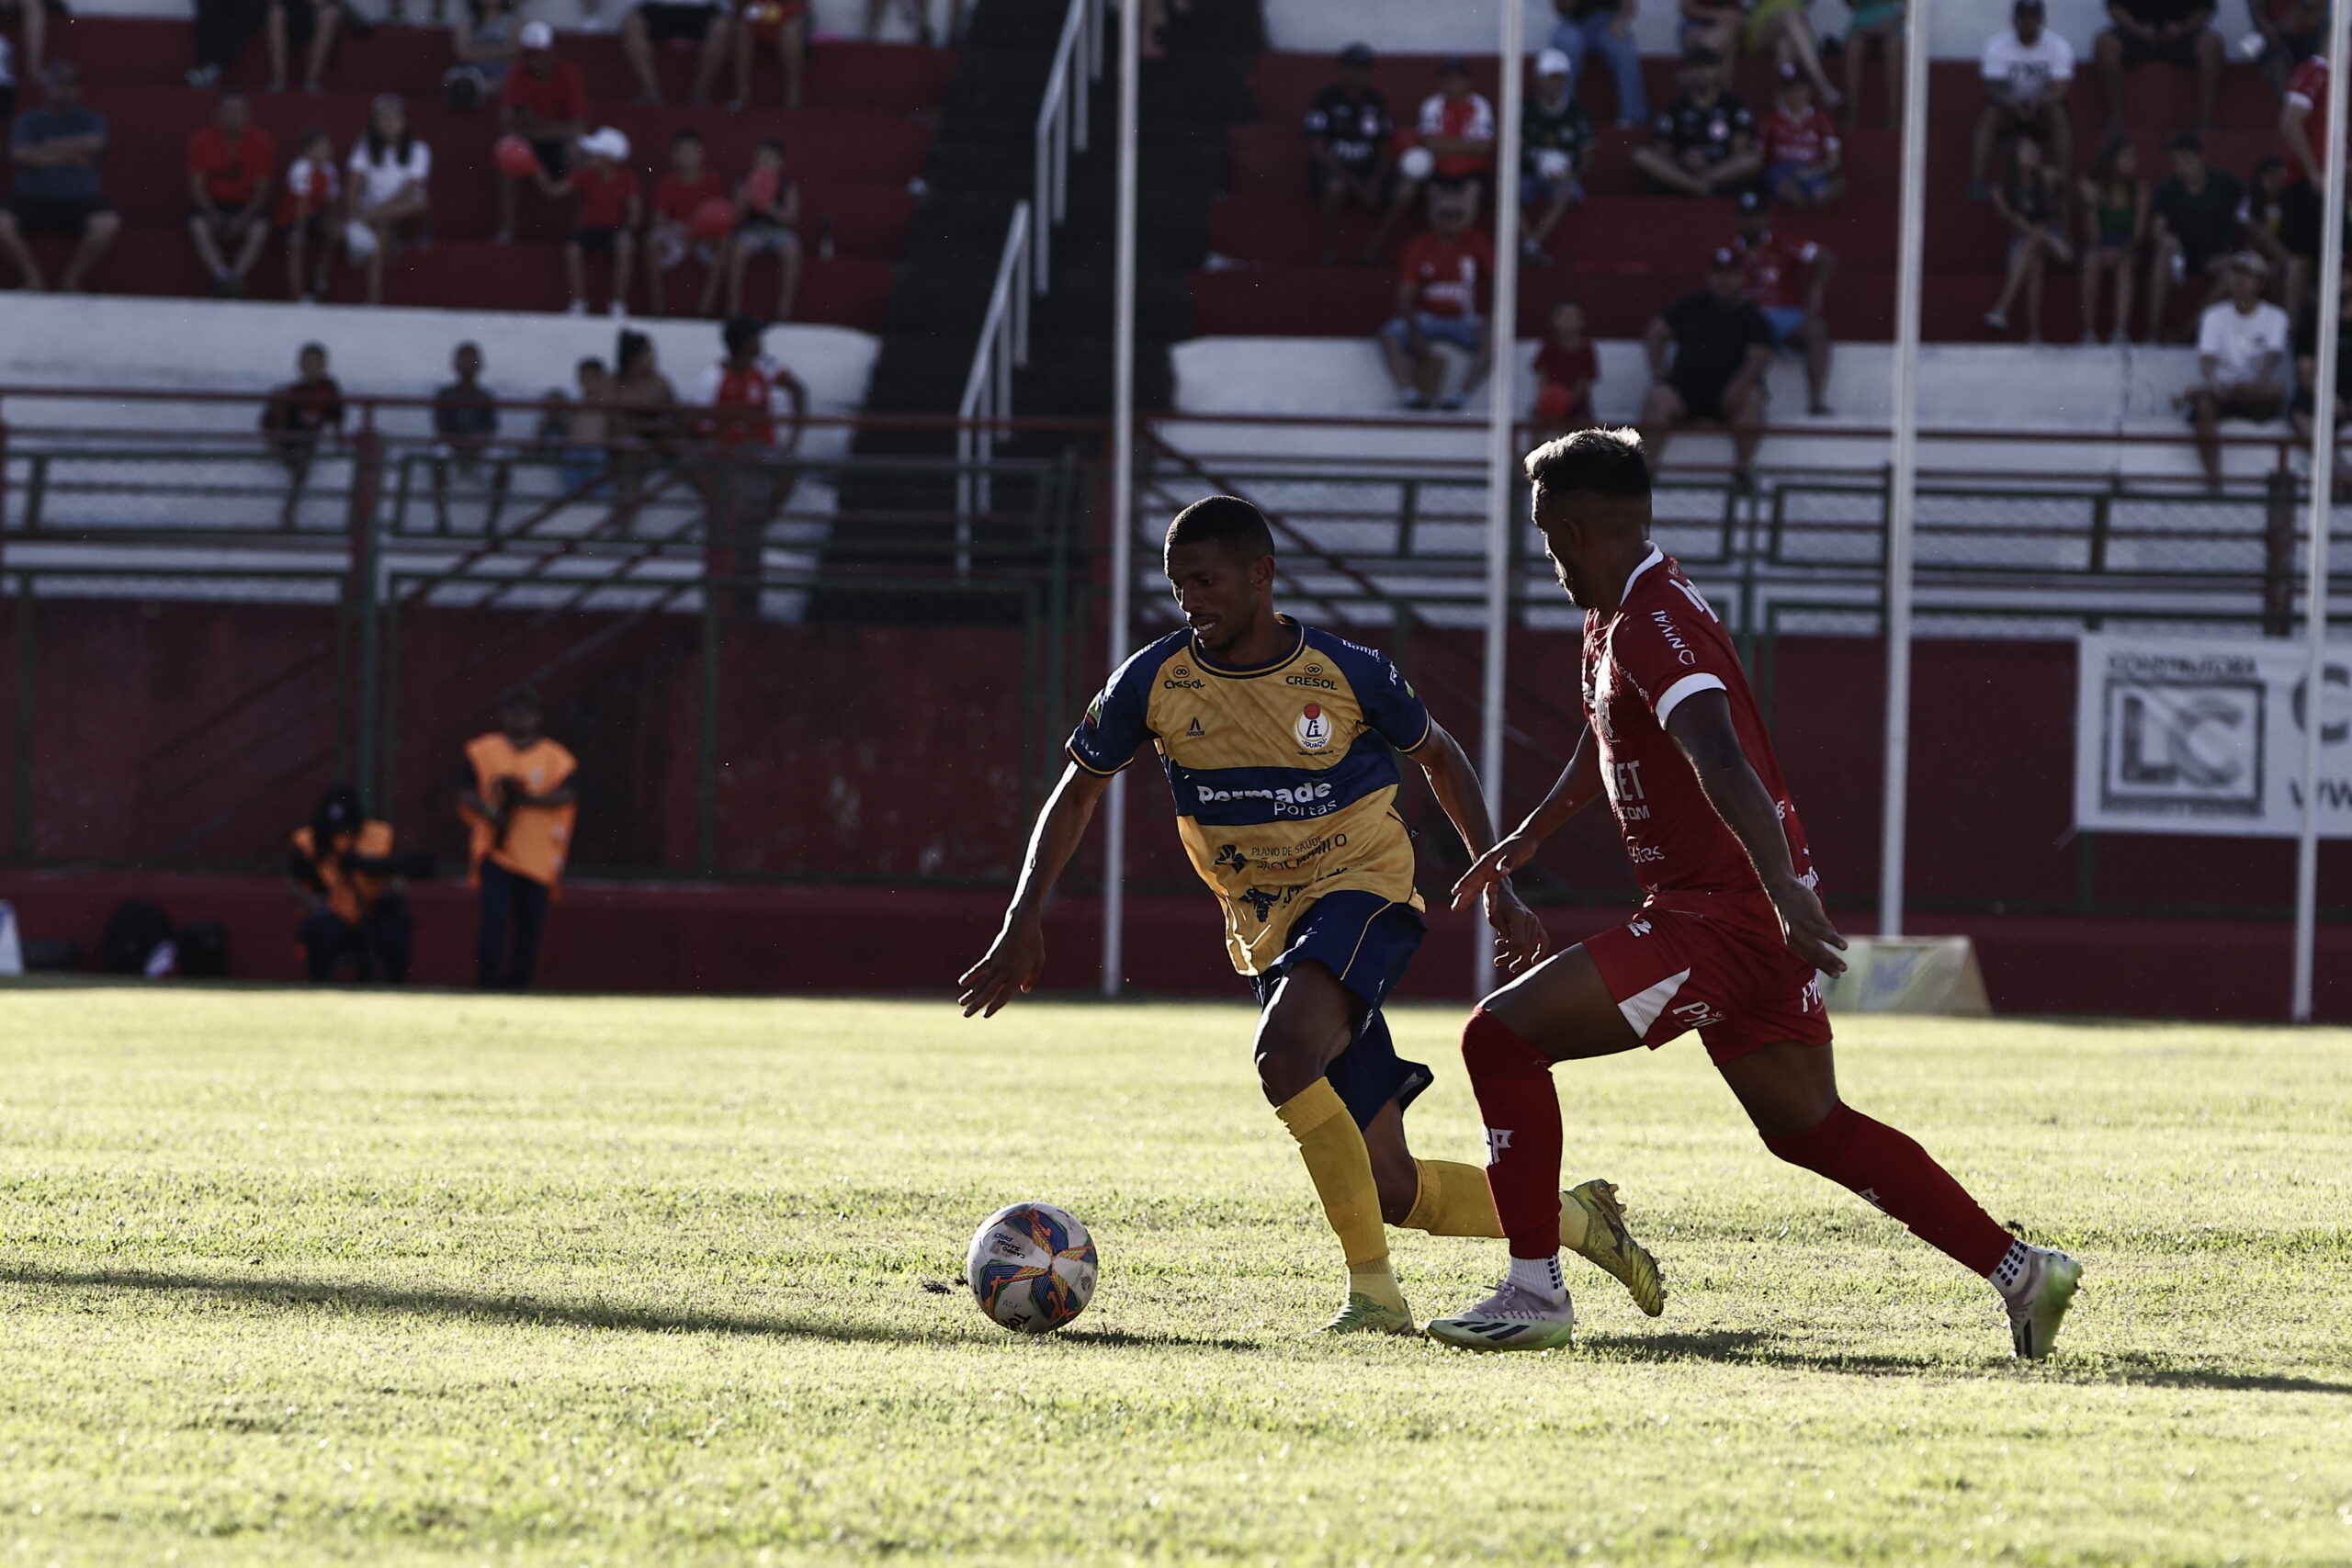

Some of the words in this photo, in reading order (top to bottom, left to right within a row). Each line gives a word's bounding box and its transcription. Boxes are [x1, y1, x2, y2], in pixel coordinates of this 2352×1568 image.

[1164, 679, 1205, 690] CRESOL
[1285, 675, 1338, 691] CRESOL
[1273, 799, 1338, 817] Portas
[1251, 847, 1281, 856] PLANO
[1282, 846, 1293, 856] DE
